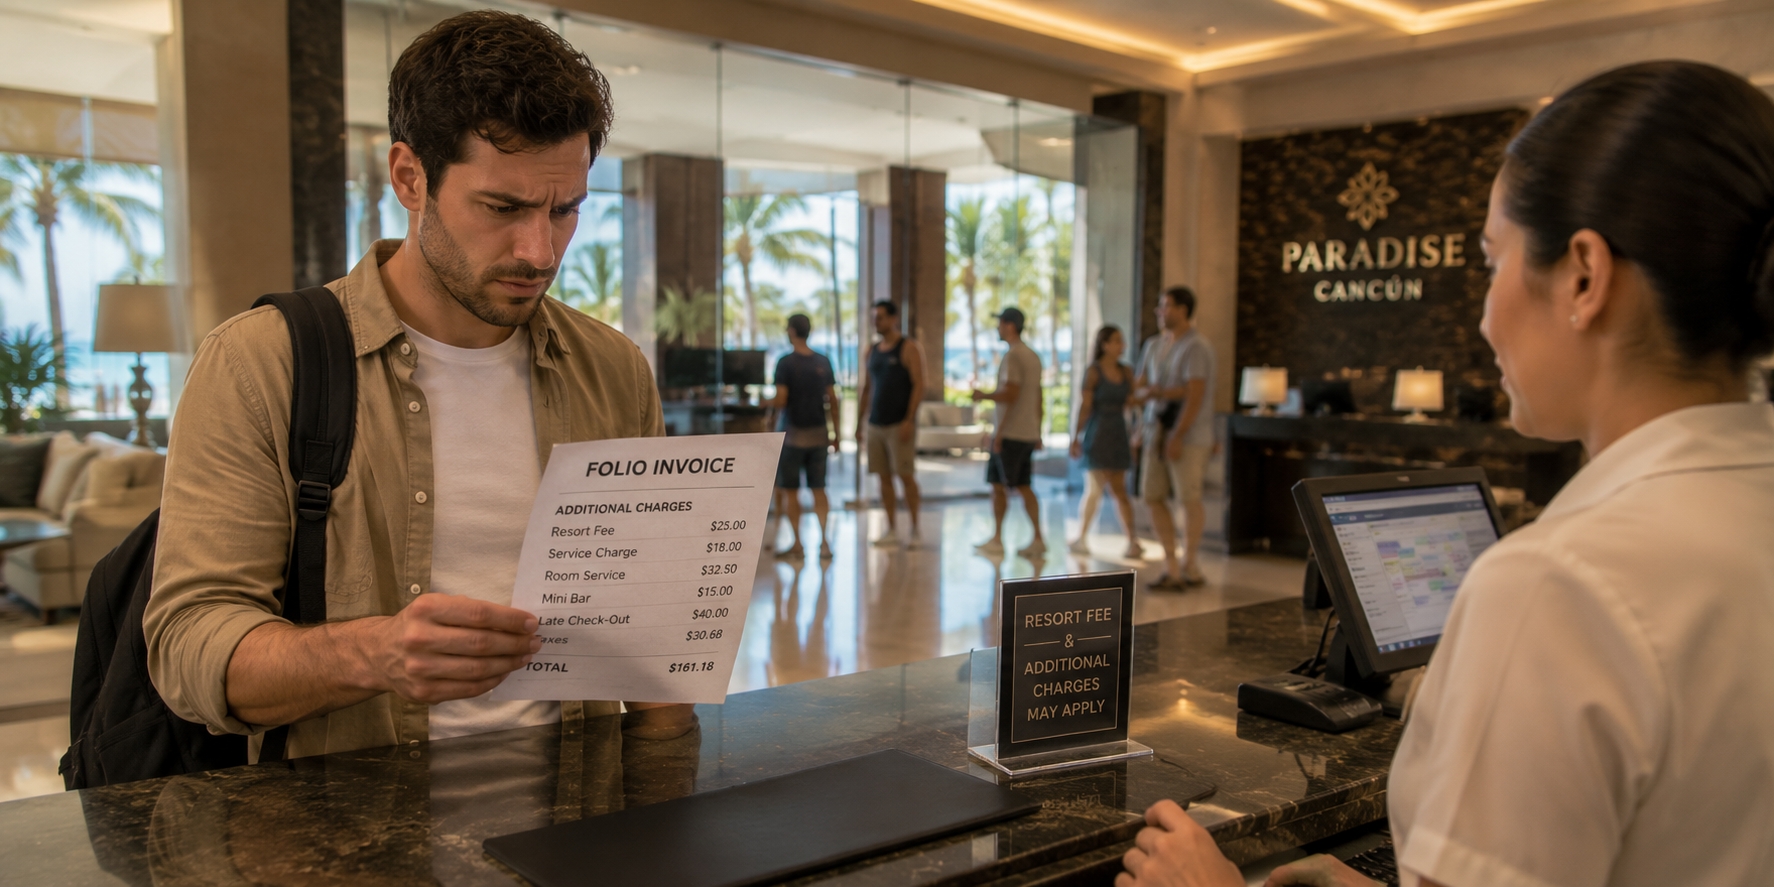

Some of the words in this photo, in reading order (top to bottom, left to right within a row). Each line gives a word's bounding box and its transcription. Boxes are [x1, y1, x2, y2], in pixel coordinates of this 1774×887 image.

[1281, 234, 1466, 273] PARADISE
[1313, 274, 1423, 302] CANCÚN
[585, 460, 647, 477] FOLIO
[653, 457, 736, 475] INVOICE
[555, 503, 632, 516] ADDITIONAL
[635, 501, 692, 513] CHARGES
[551, 526, 591, 537] Resort
[594, 525, 615, 536] Fee
[710, 520, 746, 532] $25.00
[548, 548, 592, 559] Service
[595, 547, 638, 560] Charge
[706, 541, 742, 554] $18.00
[544, 570, 580, 581] Room
[583, 570, 626, 581] Service
[701, 563, 738, 576] $32.50
[542, 593, 568, 604] Mini
[570, 593, 591, 604] Bar
[697, 585, 733, 598] $15.00
[538, 616, 564, 626] Late
[568, 614, 630, 626] Check-Out
[692, 608, 729, 620] $40.00
[1025, 611, 1082, 628] RESORT
[1086, 608, 1112, 622] FEE
[685, 629, 723, 642] $30.68
[1064, 634, 1074, 648] &
[525, 662, 569, 673] TOTAL
[668, 661, 714, 674] $161.18
[1024, 653, 1110, 675] ADDITIONAL
[1033, 677, 1100, 697] CHARGES
[1027, 705, 1059, 721] MAY
[1061, 699, 1105, 717] APPLY
